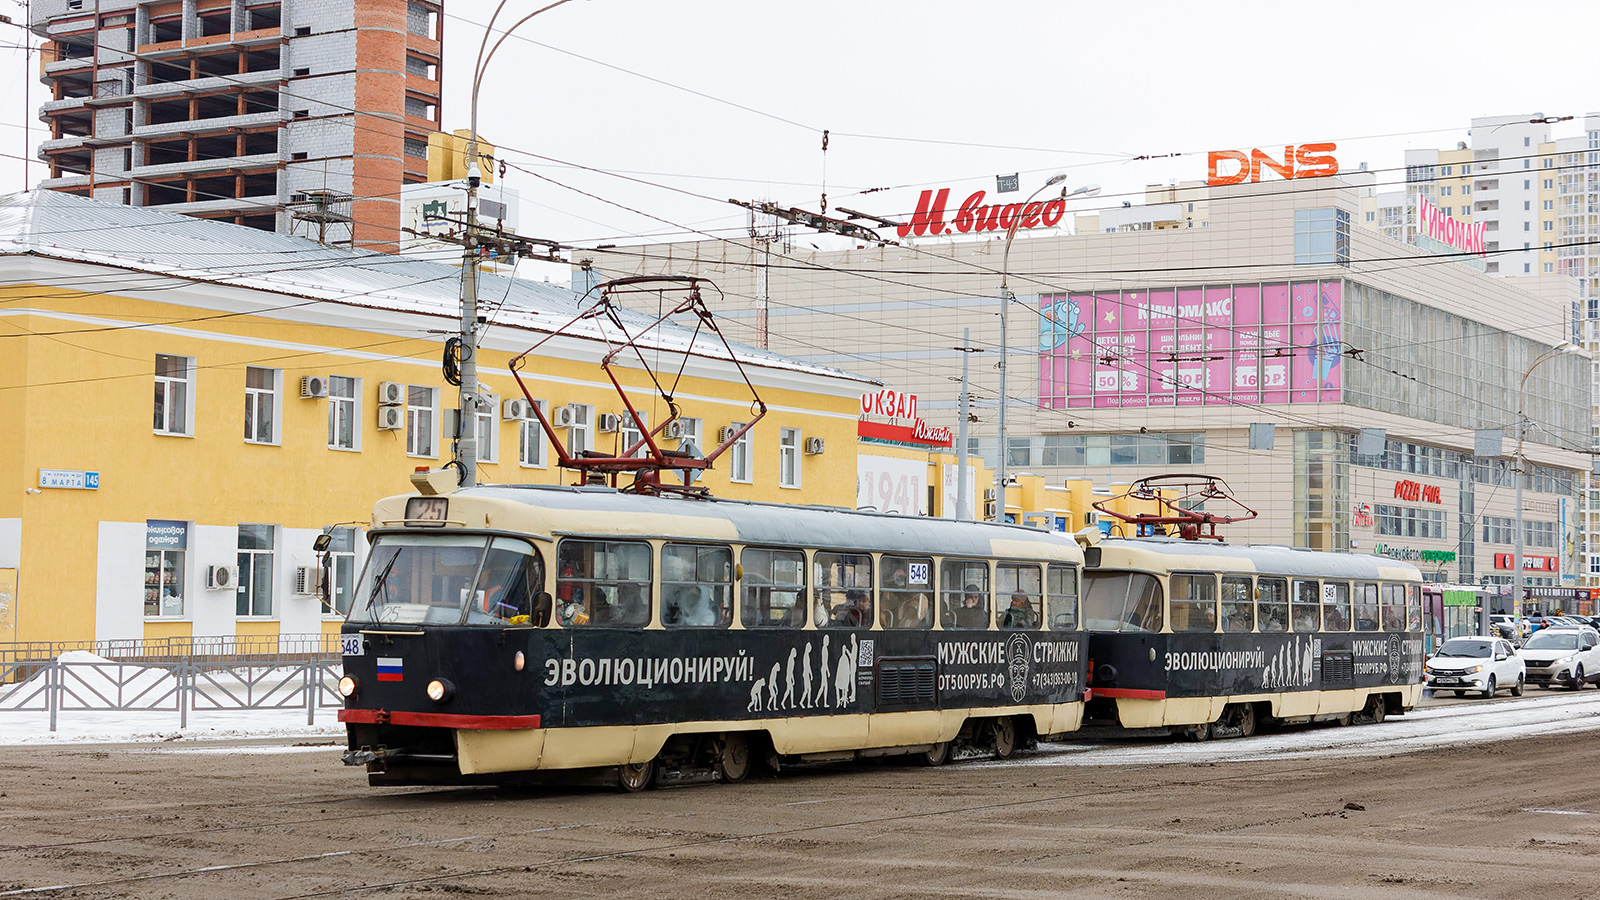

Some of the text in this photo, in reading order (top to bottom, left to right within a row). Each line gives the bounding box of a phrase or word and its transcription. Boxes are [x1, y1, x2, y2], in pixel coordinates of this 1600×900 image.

[1208, 142, 1339, 186] DNS
[896, 188, 1066, 240] М.видео
[1420, 193, 1487, 258] КИНОМАКС
[1138, 297, 1232, 320] КИНОМАКС
[1160, 333, 1212, 343] ШКЛЬНИИ
[1163, 395, 1201, 404] kinmax.ru
[914, 418, 950, 442] Южный
[42, 476, 47, 485] 8
[86, 474, 99, 486] 145
[864, 471, 919, 516] 1941
[1394, 480, 1421, 501] PIZZA
[416, 500, 442, 520] 25
[148, 536, 179, 545] одежда
[911, 566, 927, 582] 548
[380, 606, 400, 623] 25
[937, 641, 1079, 665] МУЖСКИЕ СТРИЖКИ
[1352, 640, 1388, 657] МУЖСКИЕ
[544, 649, 754, 689] ЭВОЛЮЦИОНИРУЙ!
[1164, 646, 1265, 673] ЭВОЛЮЦИОНИРУЙ!
[938, 673, 1005, 692] ОТ500РУБ.РФ
